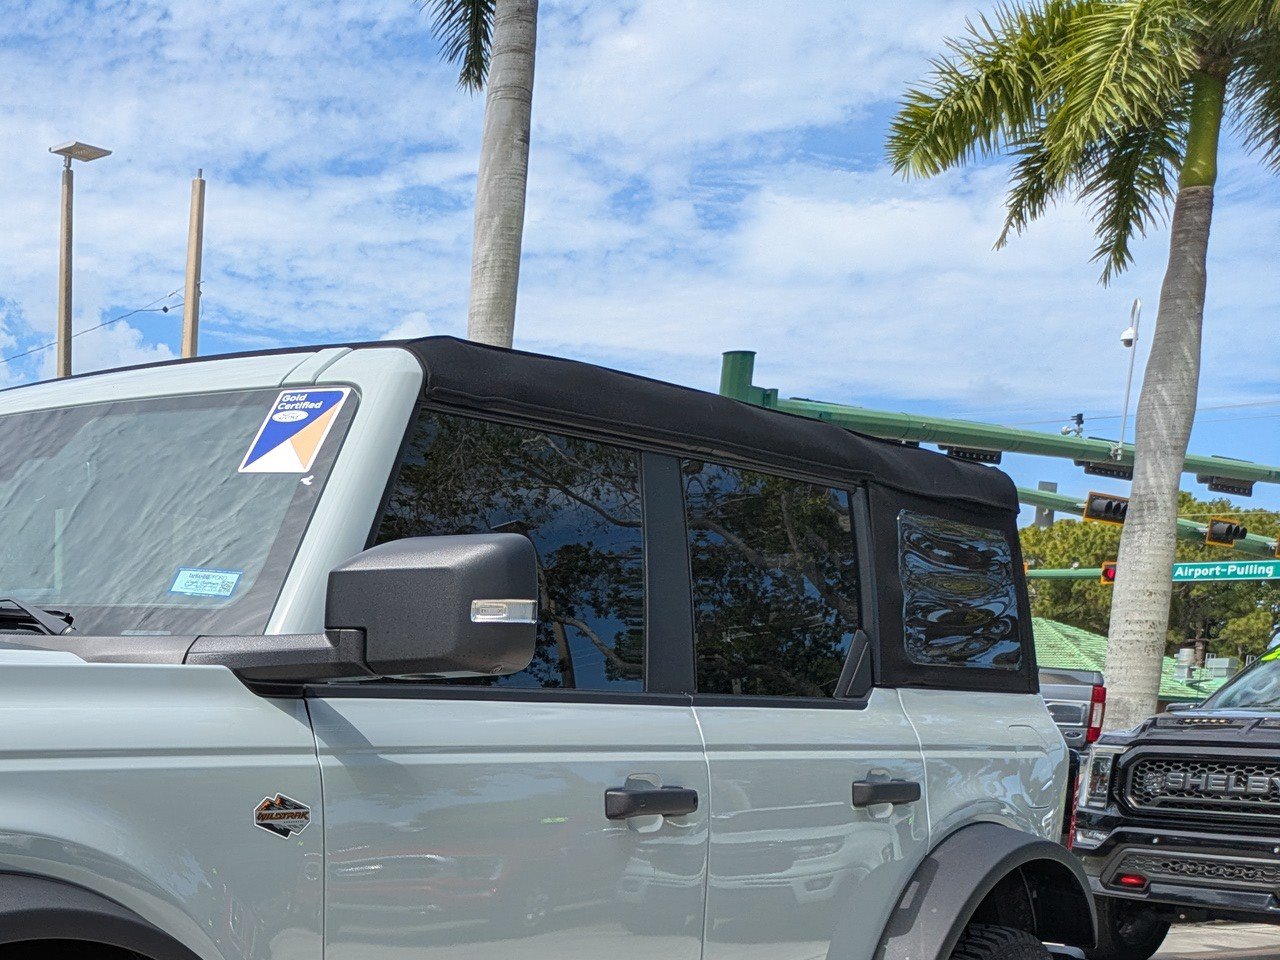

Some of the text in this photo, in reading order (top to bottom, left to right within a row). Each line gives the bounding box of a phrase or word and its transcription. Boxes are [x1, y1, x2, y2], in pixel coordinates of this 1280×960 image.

[282, 394, 307, 402] Gold
[277, 401, 324, 410] Certified
[1174, 564, 1274, 577] Airport-Pulling
[256, 811, 310, 822] WILDTRAK
